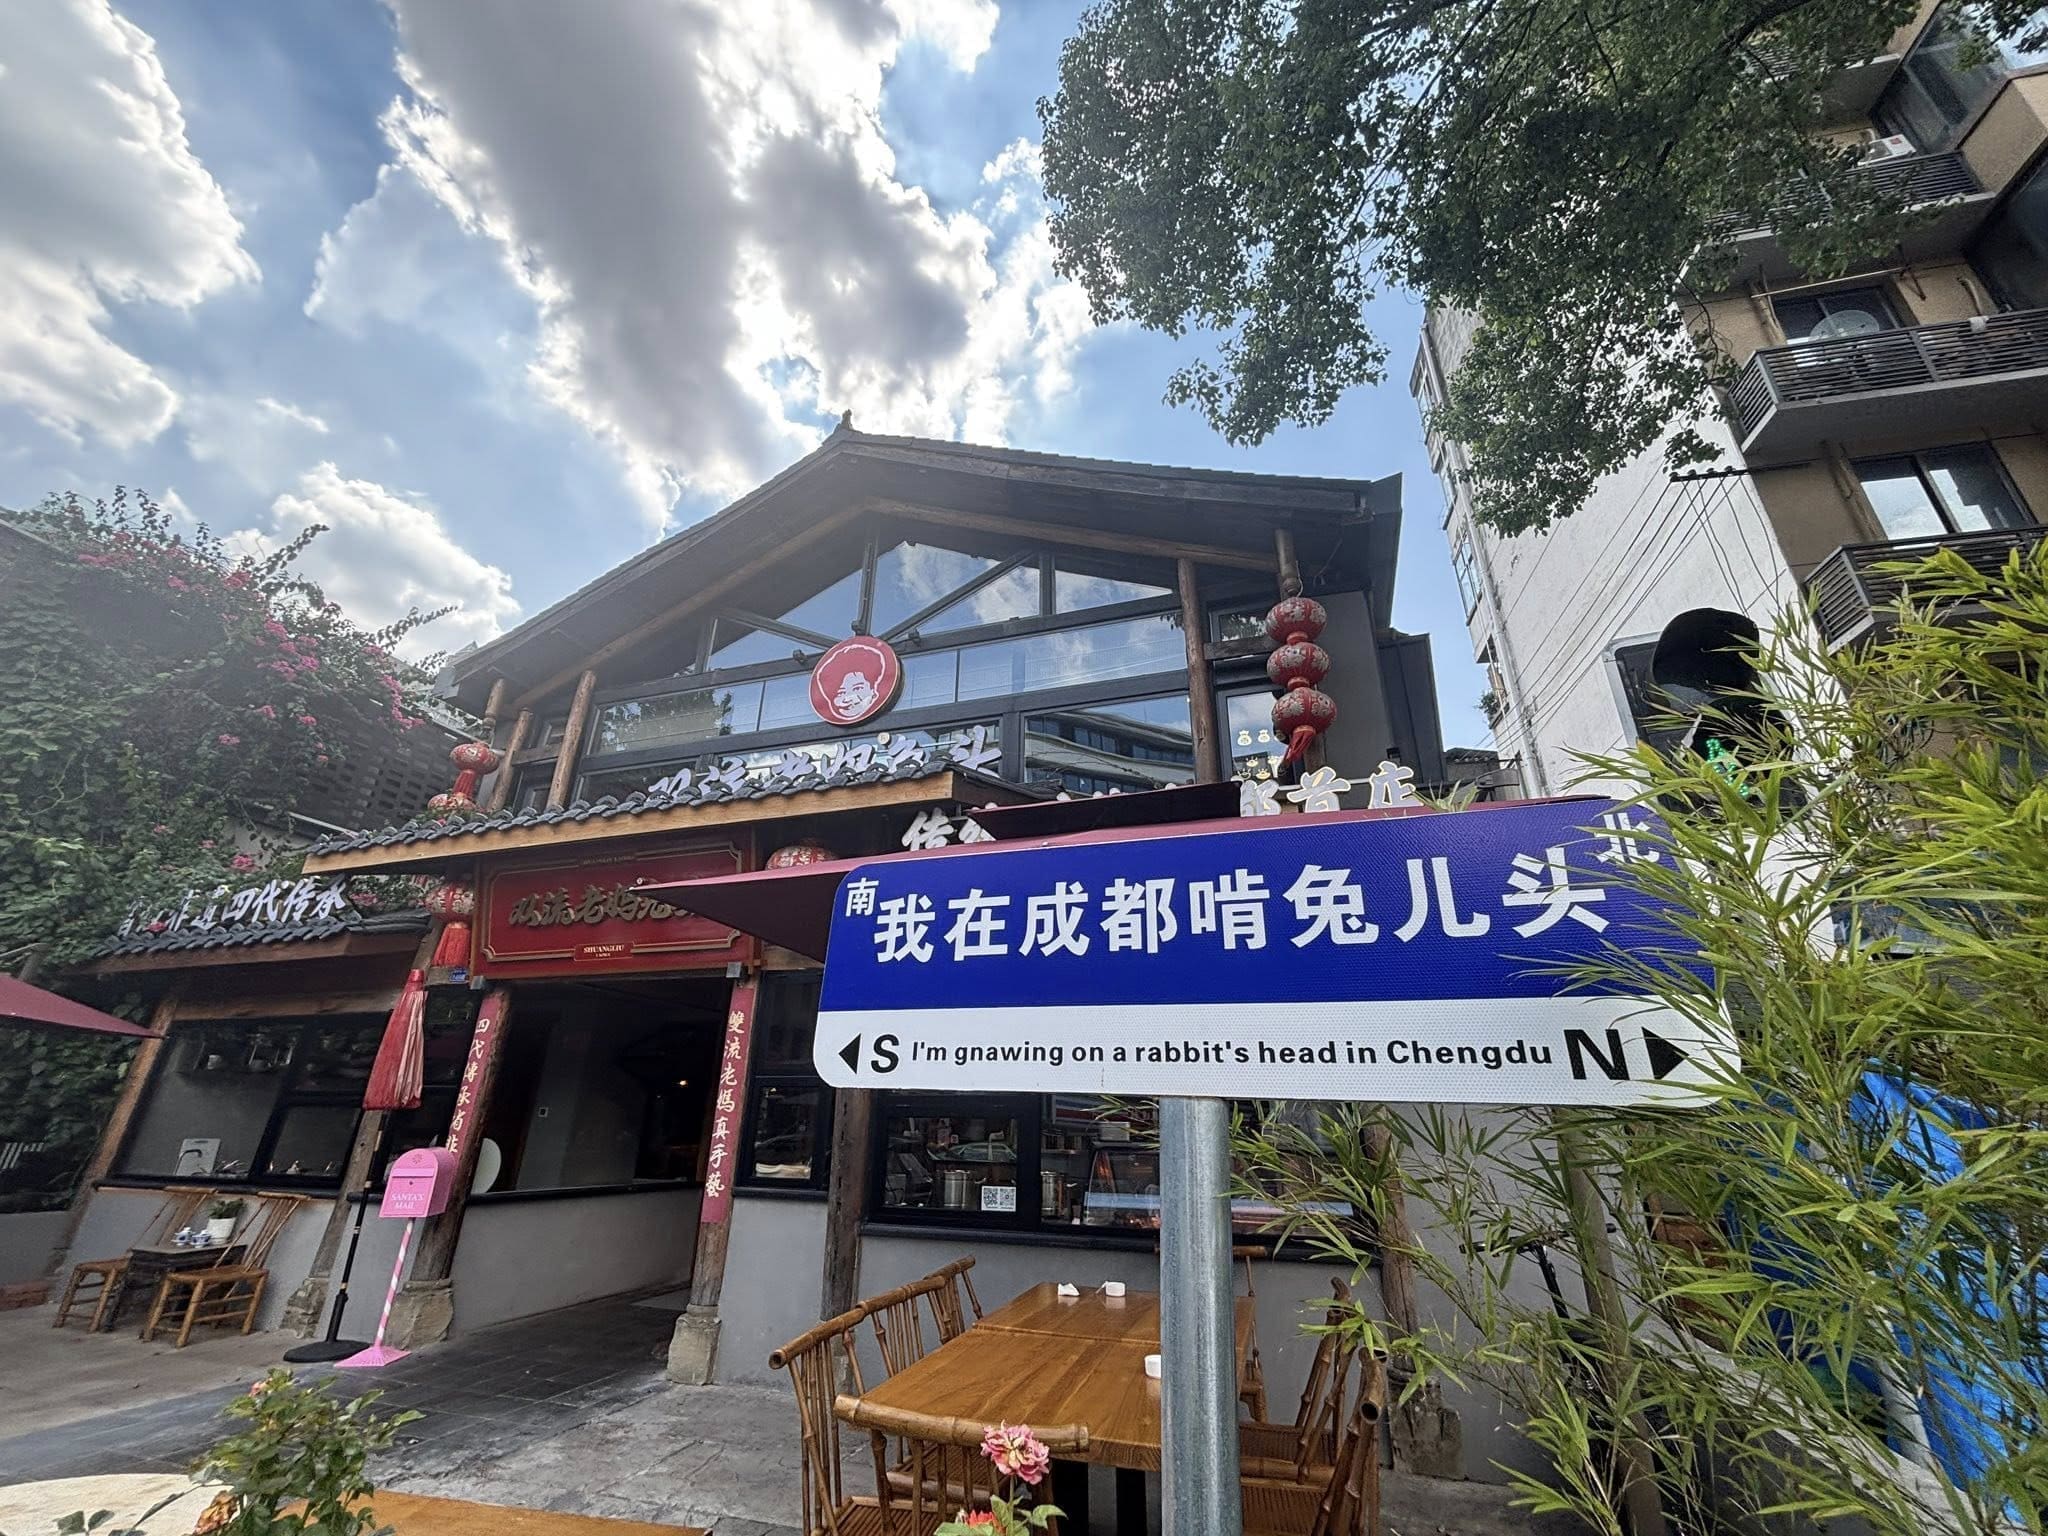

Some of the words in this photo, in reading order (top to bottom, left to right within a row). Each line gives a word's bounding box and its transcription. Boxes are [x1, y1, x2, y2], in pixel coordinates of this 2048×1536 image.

[1595, 812, 1660, 864] 北
[845, 877, 880, 918] 南
[873, 846, 1610, 963] 我在成都啃兔儿头
[871, 1033, 900, 1074] S
[912, 1041, 947, 1062] I'm
[955, 1041, 1063, 1067] gnawing
[1071, 1043, 1104, 1062] on
[1113, 1043, 1126, 1062] a
[1135, 1040, 1250, 1062] rabbit's
[1259, 1040, 1337, 1063] head
[1347, 1040, 1376, 1063] in
[1387, 1040, 1552, 1069] Chengdu
[1564, 1028, 1630, 1081] N
[704, 1010, 746, 1199] 雙流老媽真手藝
[395, 1201, 416, 1209] MAIL
